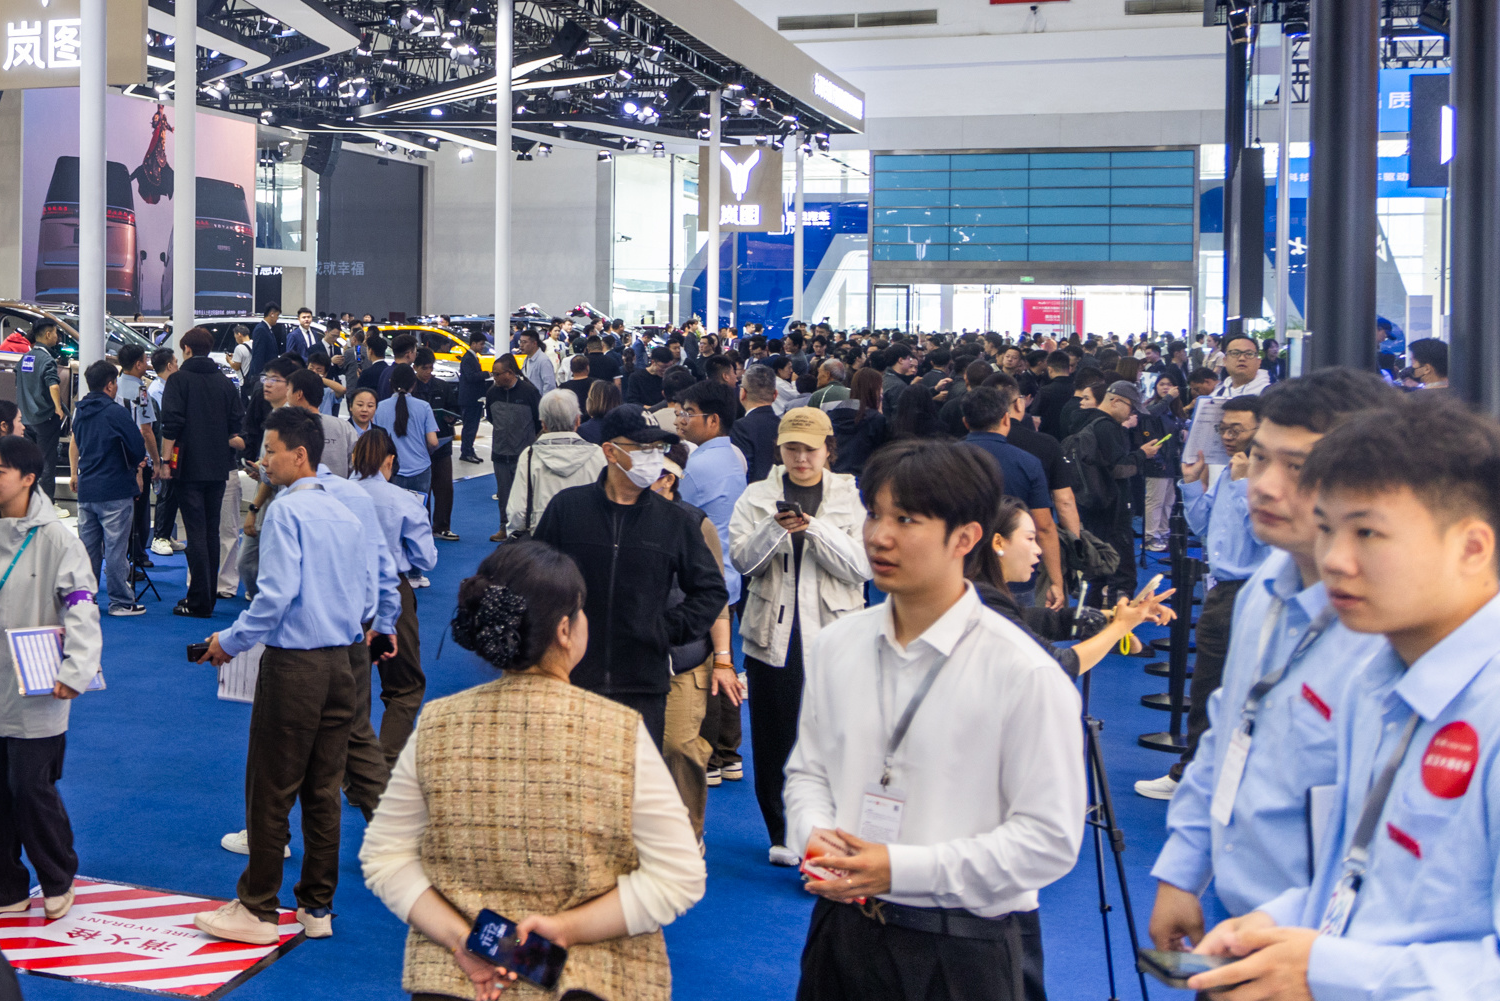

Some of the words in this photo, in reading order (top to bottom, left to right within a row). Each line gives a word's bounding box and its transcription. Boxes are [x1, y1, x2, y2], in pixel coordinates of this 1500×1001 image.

[2, 18, 81, 71] 岚图
[76, 915, 159, 933] HYDRANT
[160, 929, 199, 939] FIRE
[66, 927, 178, 952] 消火栓
